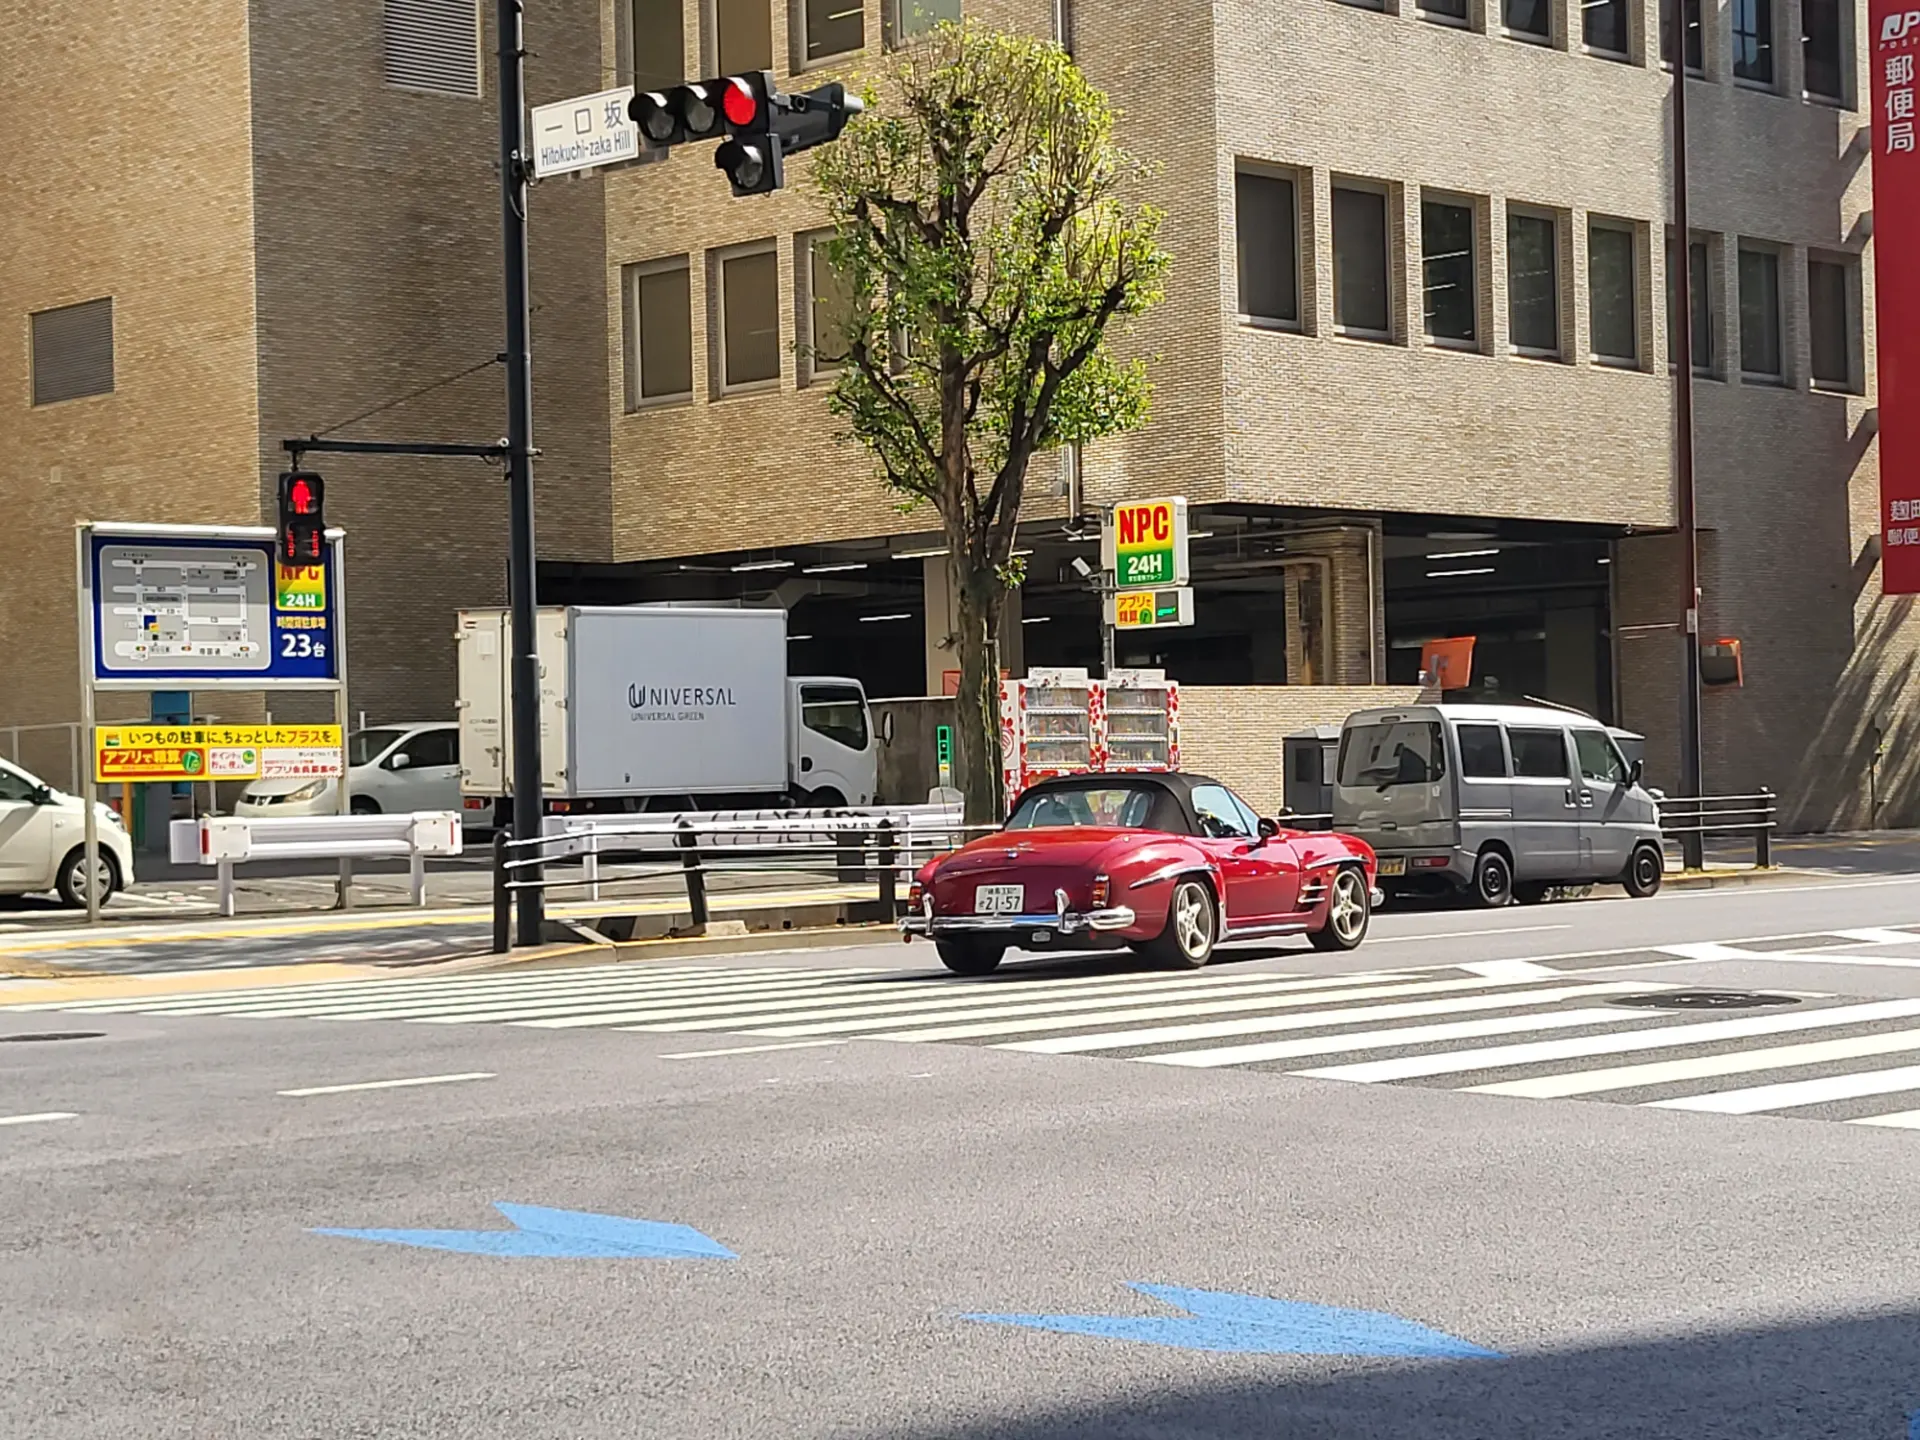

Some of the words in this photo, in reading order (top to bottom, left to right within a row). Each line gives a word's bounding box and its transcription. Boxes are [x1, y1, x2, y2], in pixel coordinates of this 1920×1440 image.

[545, 100, 623, 135] 一口坂
[1885, 55, 1915, 155] 郵便局
[541, 136, 612, 166] Hitokuchi-zaka
[614, 130, 631, 152] Hill
[1119, 506, 1169, 544] NPC
[1128, 554, 1162, 575] 24H
[286, 594, 316, 607] 24H
[628, 683, 737, 709] UNIVERSAL
[630, 712, 676, 722] UNIVERSAL
[677, 712, 705, 721] GREEN
